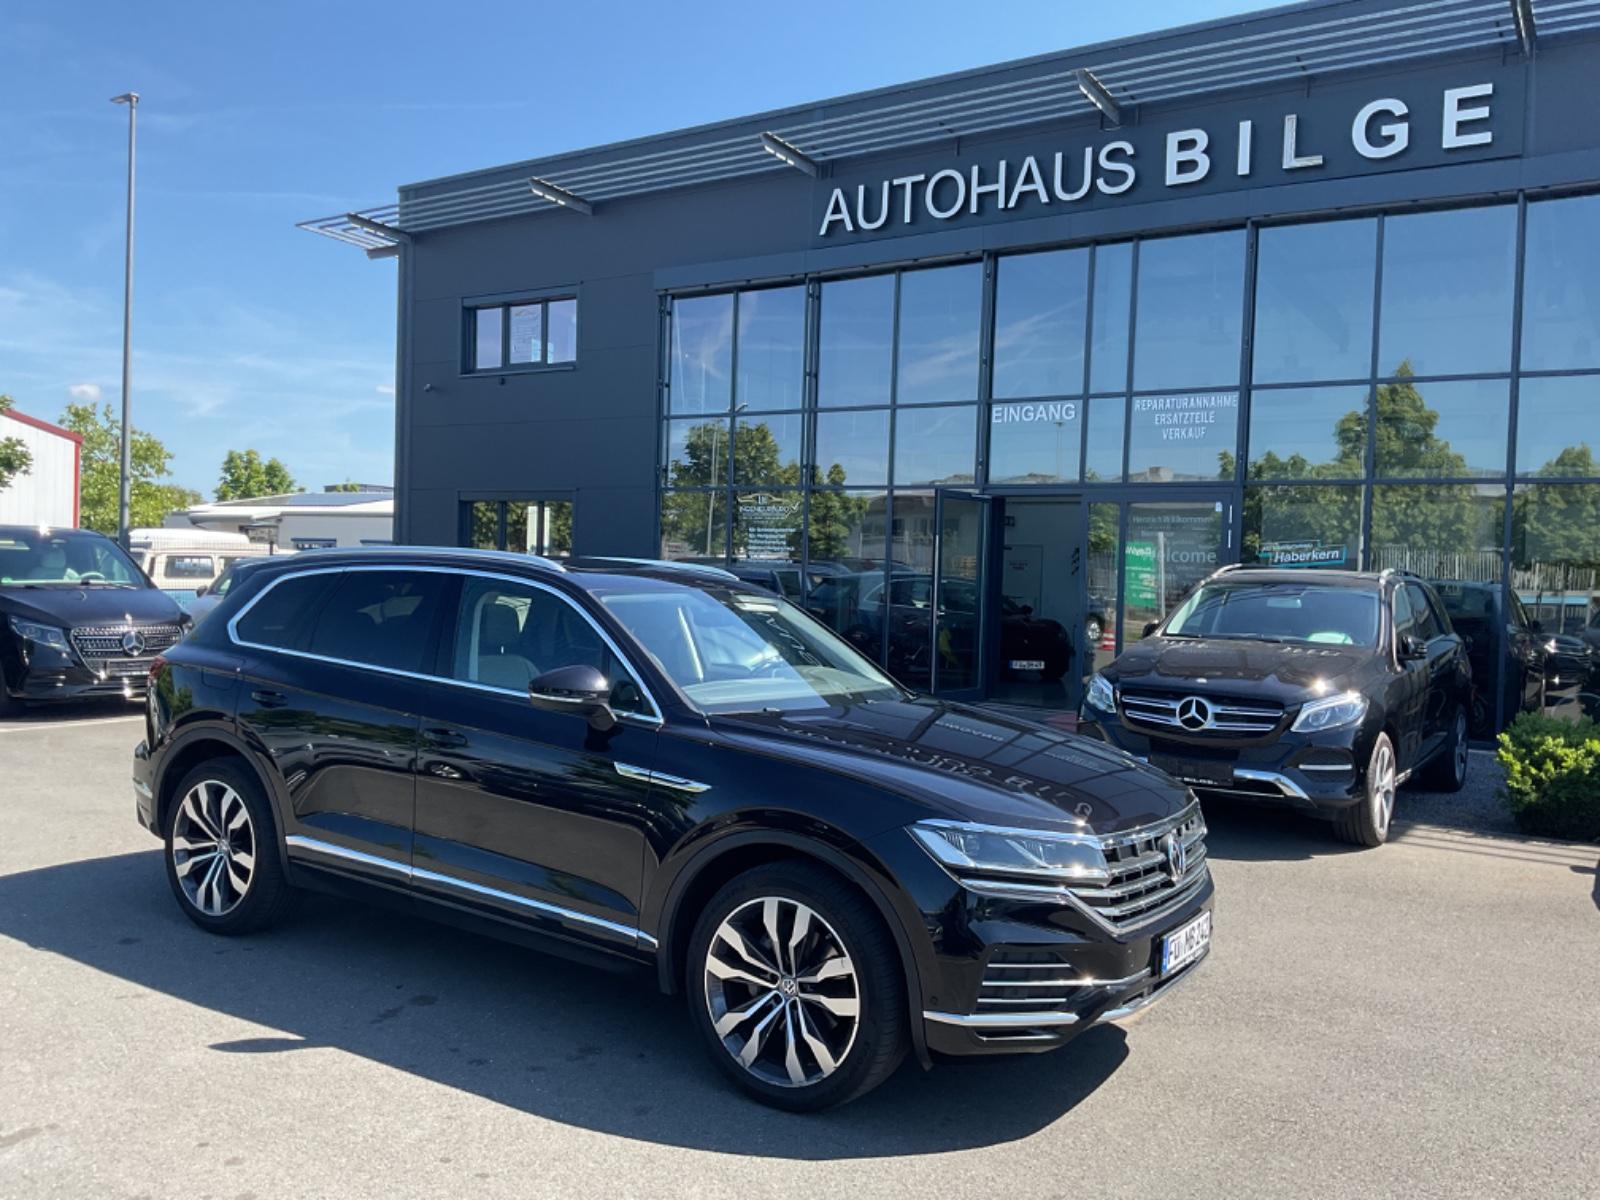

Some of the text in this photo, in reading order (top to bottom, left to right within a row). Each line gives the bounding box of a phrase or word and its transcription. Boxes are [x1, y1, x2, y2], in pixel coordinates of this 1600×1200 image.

[819, 83, 1494, 236] AUTOHAUS BILGE
[1135, 395, 1238, 411] REPARATURANNAHME
[992, 403, 1075, 423] EINGANG
[1154, 411, 1216, 425] ERSATZTEILE
[1162, 427, 1207, 440] VERKAUF
[1273, 549, 1340, 563] Haberkern
